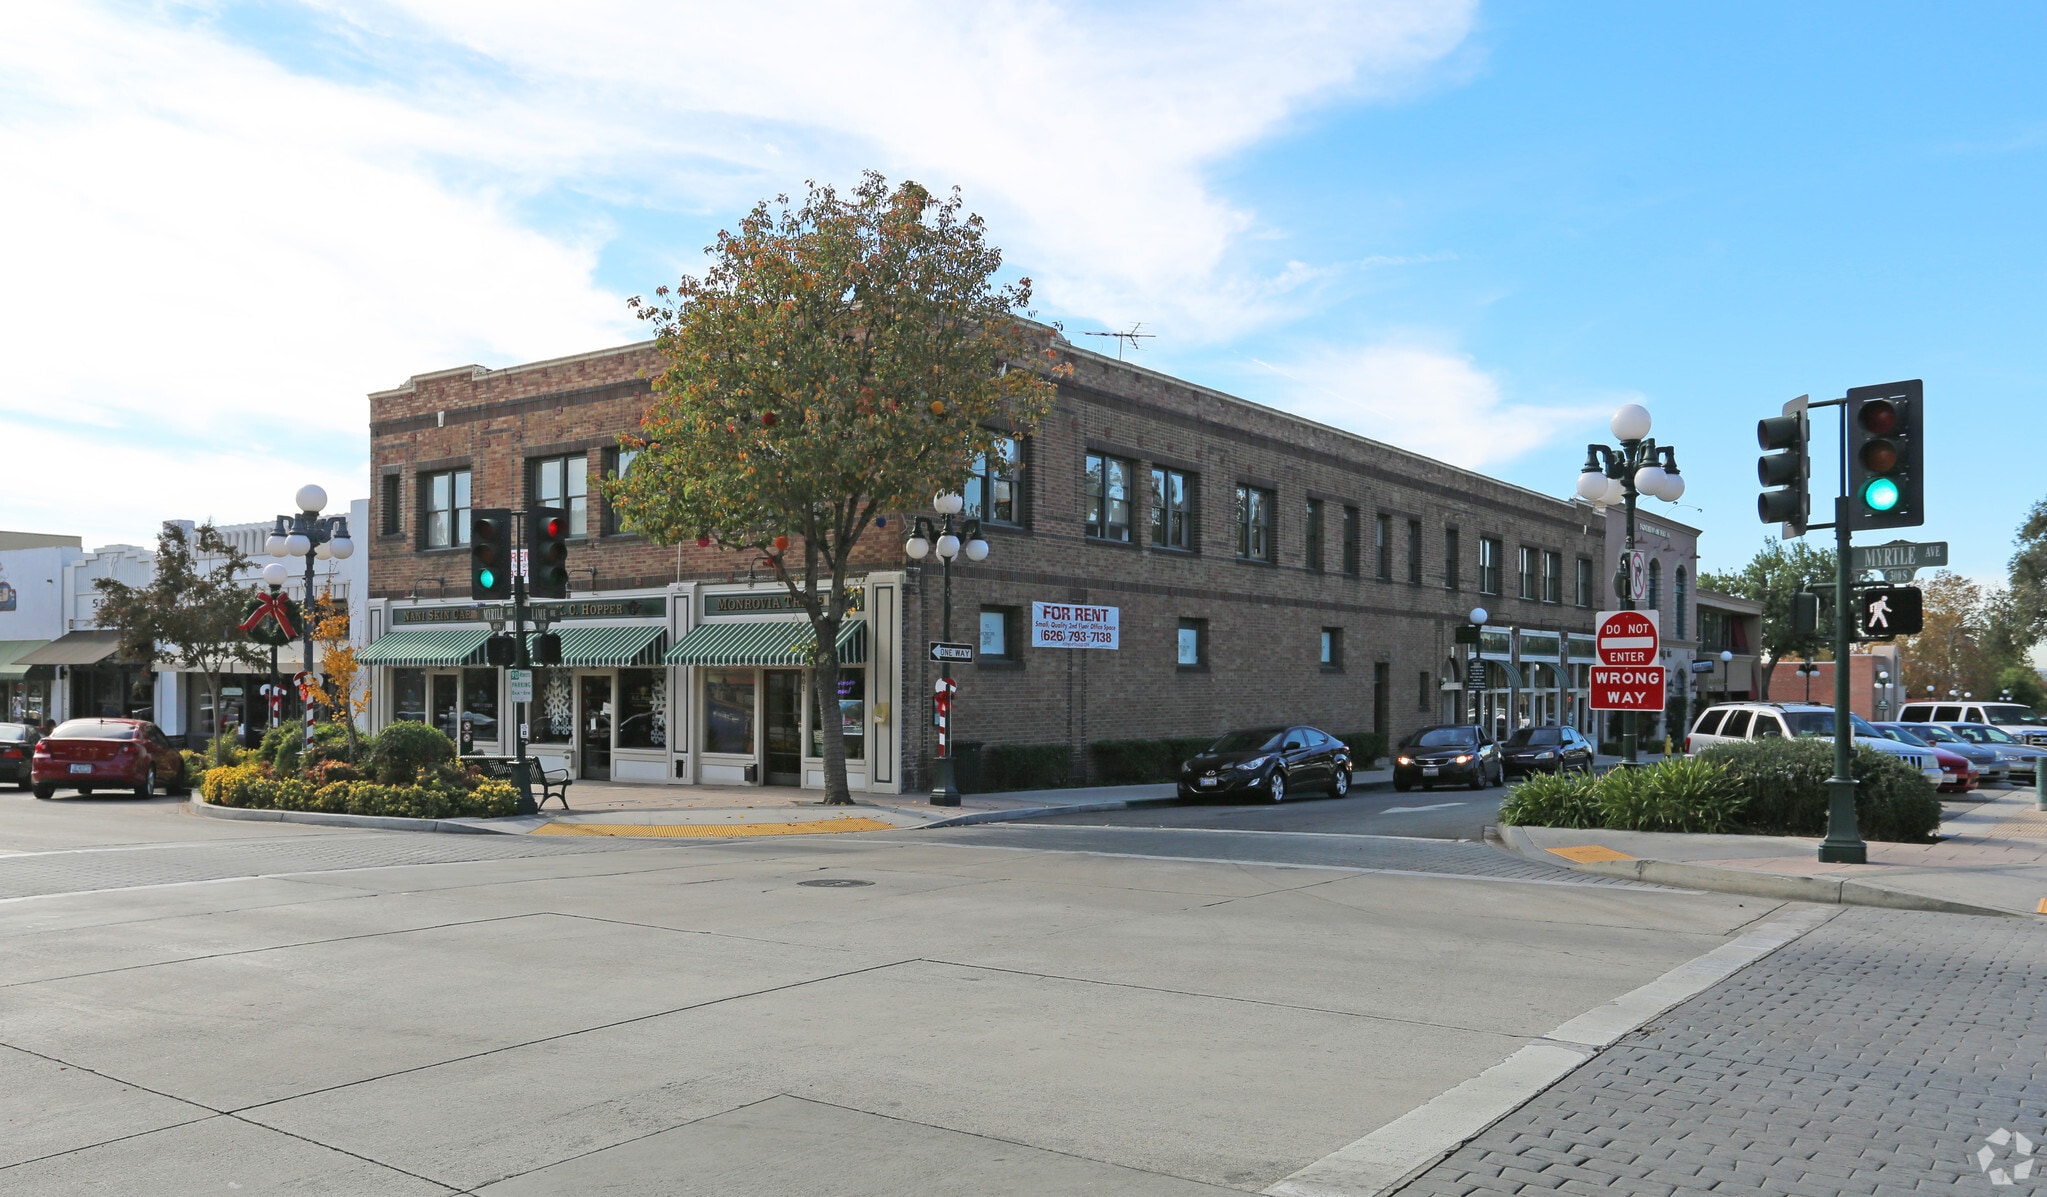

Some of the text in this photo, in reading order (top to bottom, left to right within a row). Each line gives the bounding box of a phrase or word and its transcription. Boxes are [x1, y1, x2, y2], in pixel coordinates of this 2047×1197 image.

[1865, 546, 1940, 566] MYRTLE AVE
[569, 604, 578, 616] C.
[581, 603, 623, 615] HOPPER
[717, 598, 781, 610] MONROVIA
[403, 610, 425, 622] NANI
[428, 609, 450, 621] SKIN
[483, 608, 504, 620] MYRTLE
[1043, 605, 1109, 622] FOR RENT
[1035, 620, 1049, 629] Small,
[1051, 621, 1067, 630] Quality
[1103, 624, 1116, 632] Space
[1606, 623, 1649, 635] DO NOT
[1040, 629, 1112, 643] (626) 793-7138
[940, 648, 970, 657] ONE WAY
[1610, 652, 1645, 662] ENTER
[1595, 671, 1660, 685] WRONG
[511, 681, 531, 689] PARKING
[1607, 691, 1647, 704] WAY
